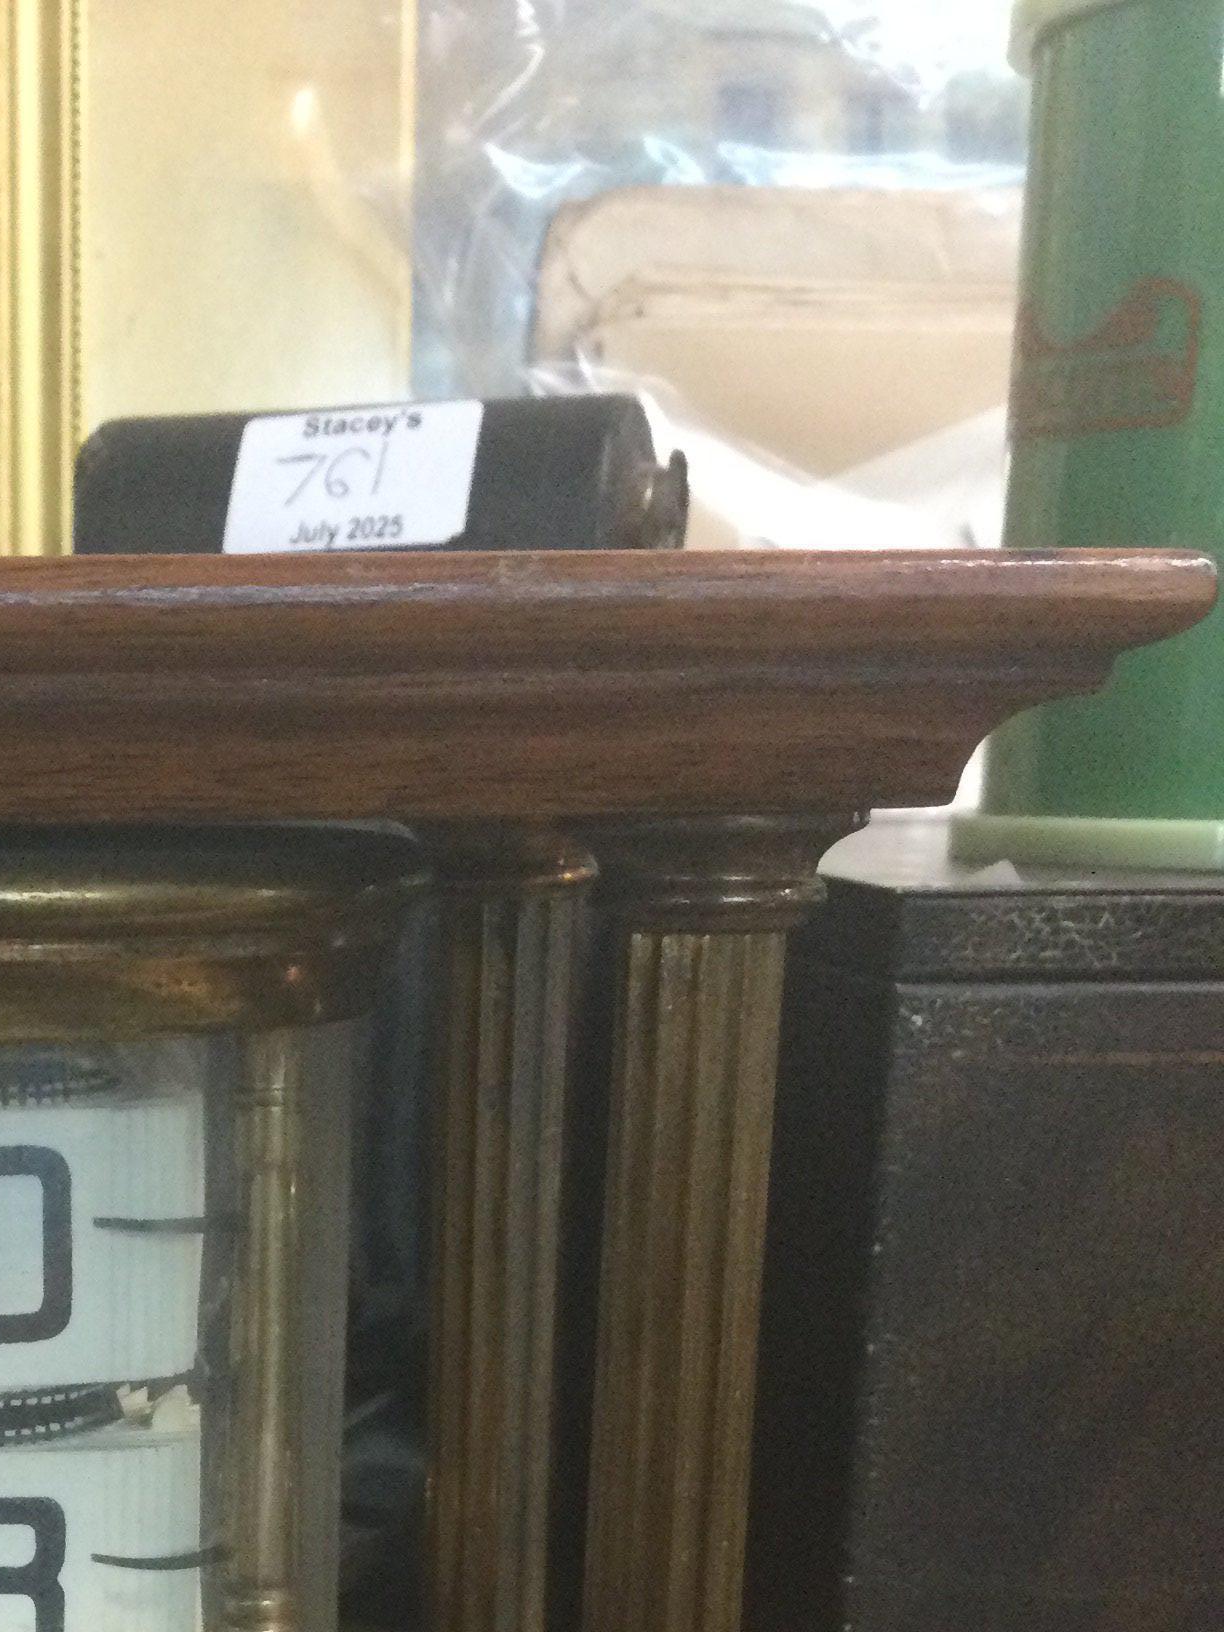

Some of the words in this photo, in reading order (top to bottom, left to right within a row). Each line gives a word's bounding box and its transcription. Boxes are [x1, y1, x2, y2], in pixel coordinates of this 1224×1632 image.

[302, 410, 423, 438] Stacey's
[275, 438, 390, 507] 761
[289, 521, 339, 547] July
[346, 514, 404, 540] 2025
